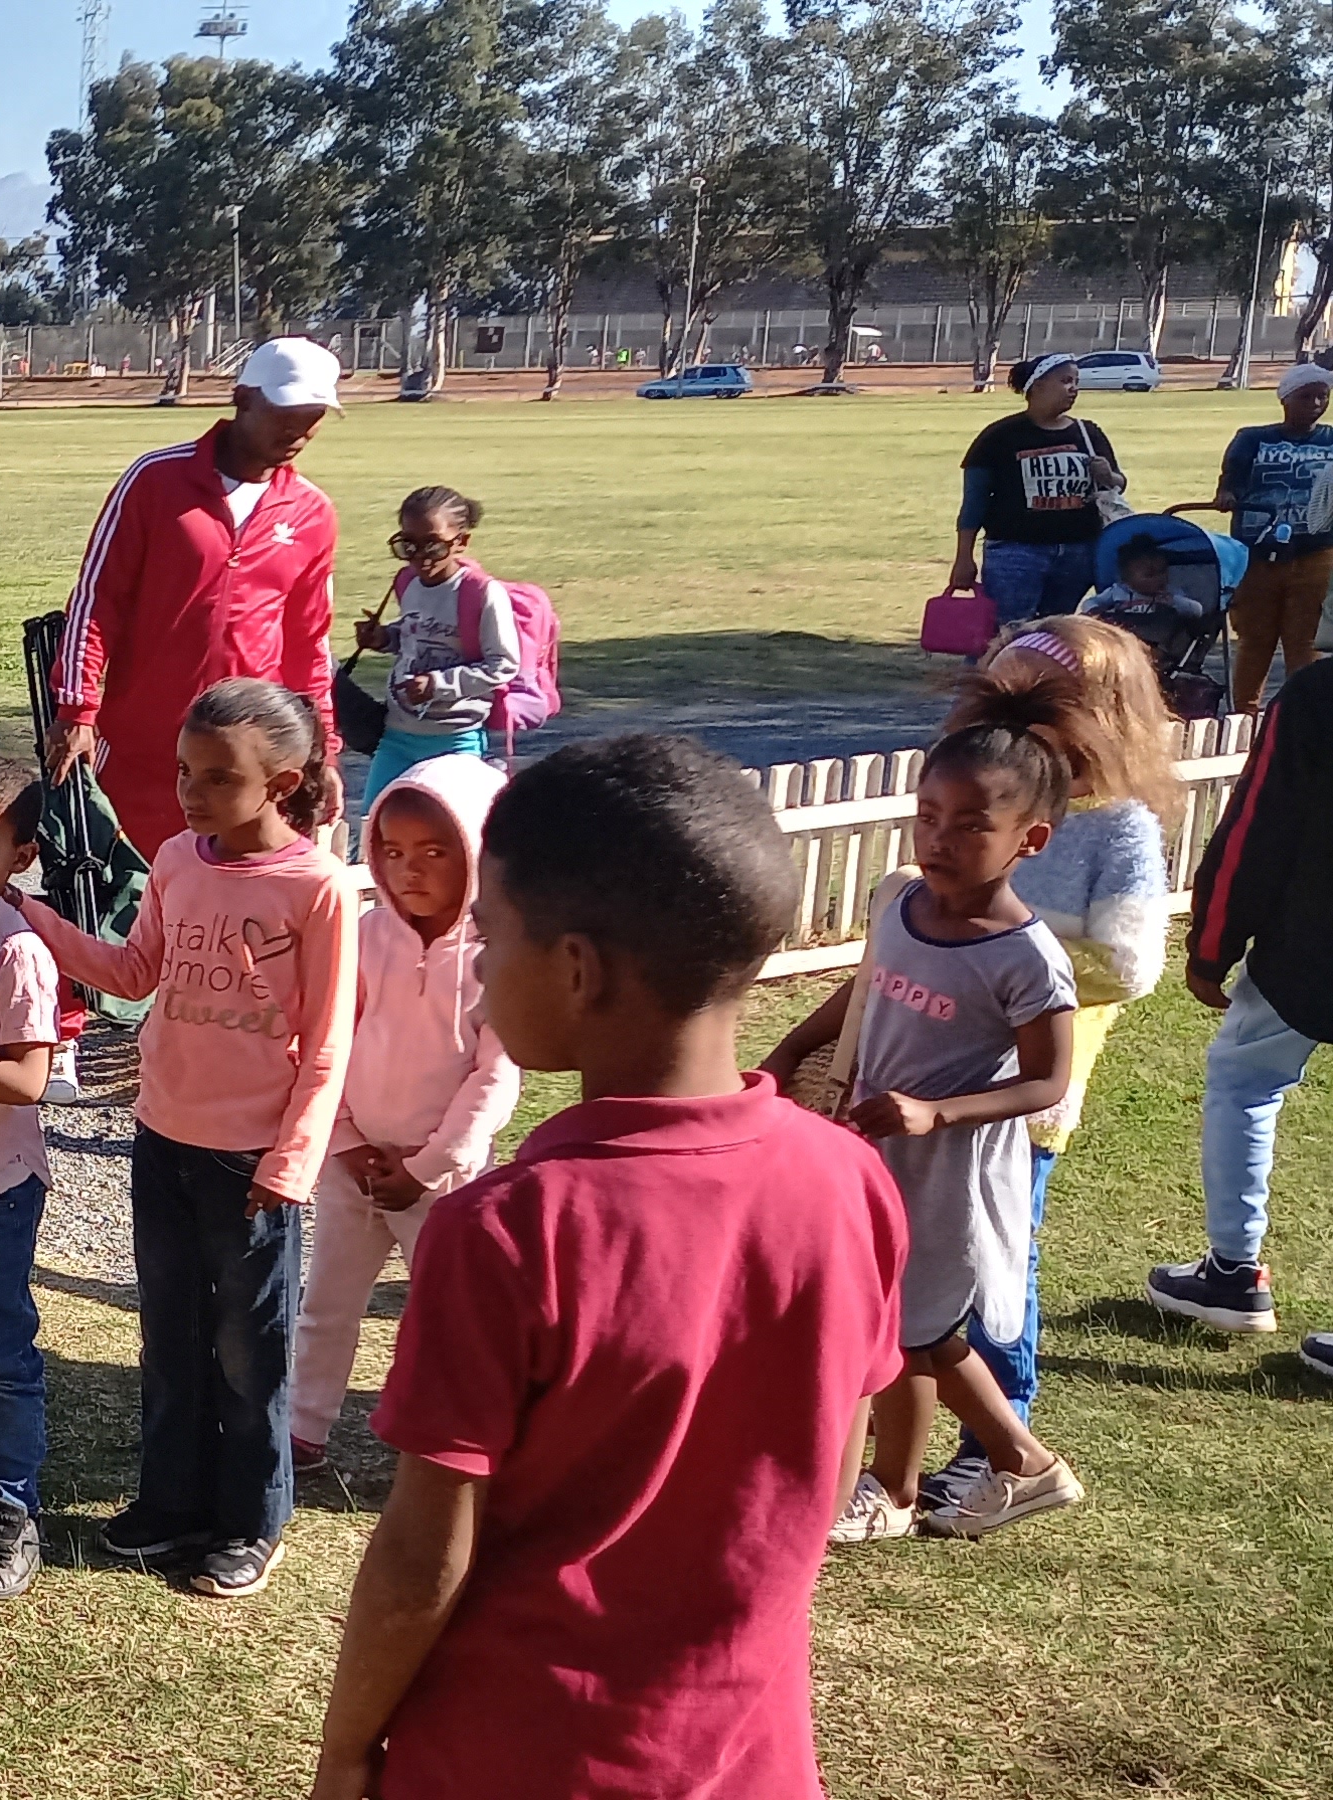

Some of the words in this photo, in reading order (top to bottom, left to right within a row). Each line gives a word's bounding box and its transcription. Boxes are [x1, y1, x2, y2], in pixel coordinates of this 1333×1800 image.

[1030, 455, 1090, 478] RELAY
[176, 913, 237, 955] talk
[175, 958, 270, 1000] more
[164, 984, 286, 1039] tweet
